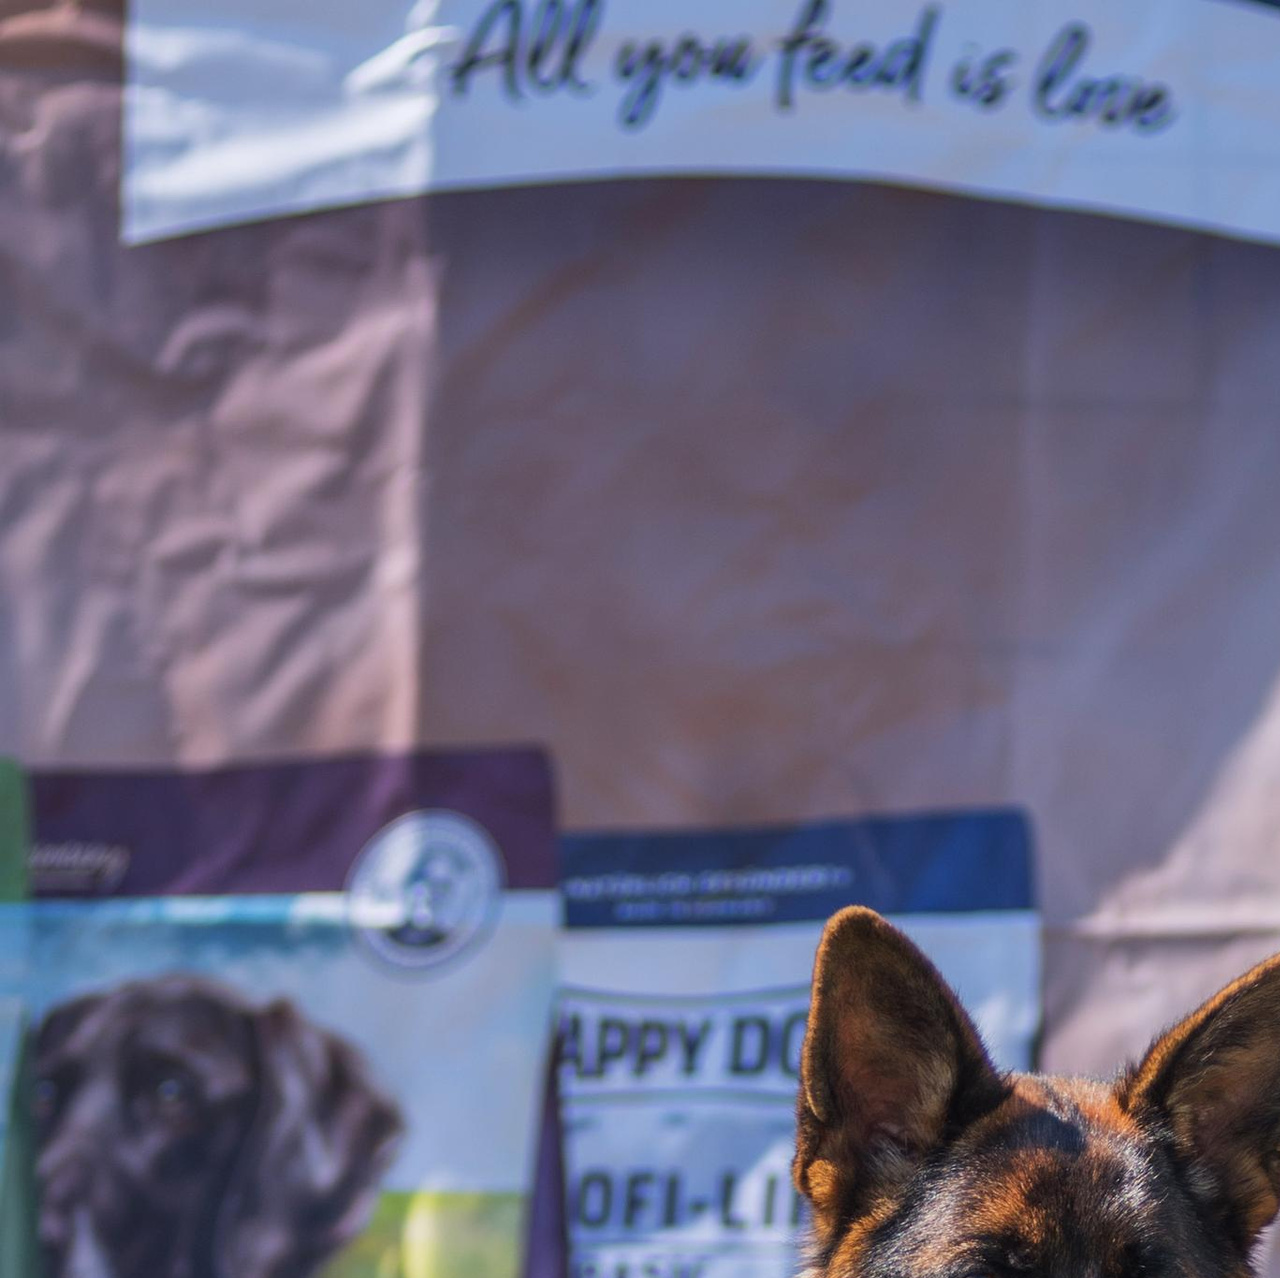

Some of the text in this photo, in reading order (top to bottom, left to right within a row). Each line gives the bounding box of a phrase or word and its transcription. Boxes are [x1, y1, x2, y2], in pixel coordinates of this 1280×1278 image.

[448, 0, 1178, 133] All you feed is love
